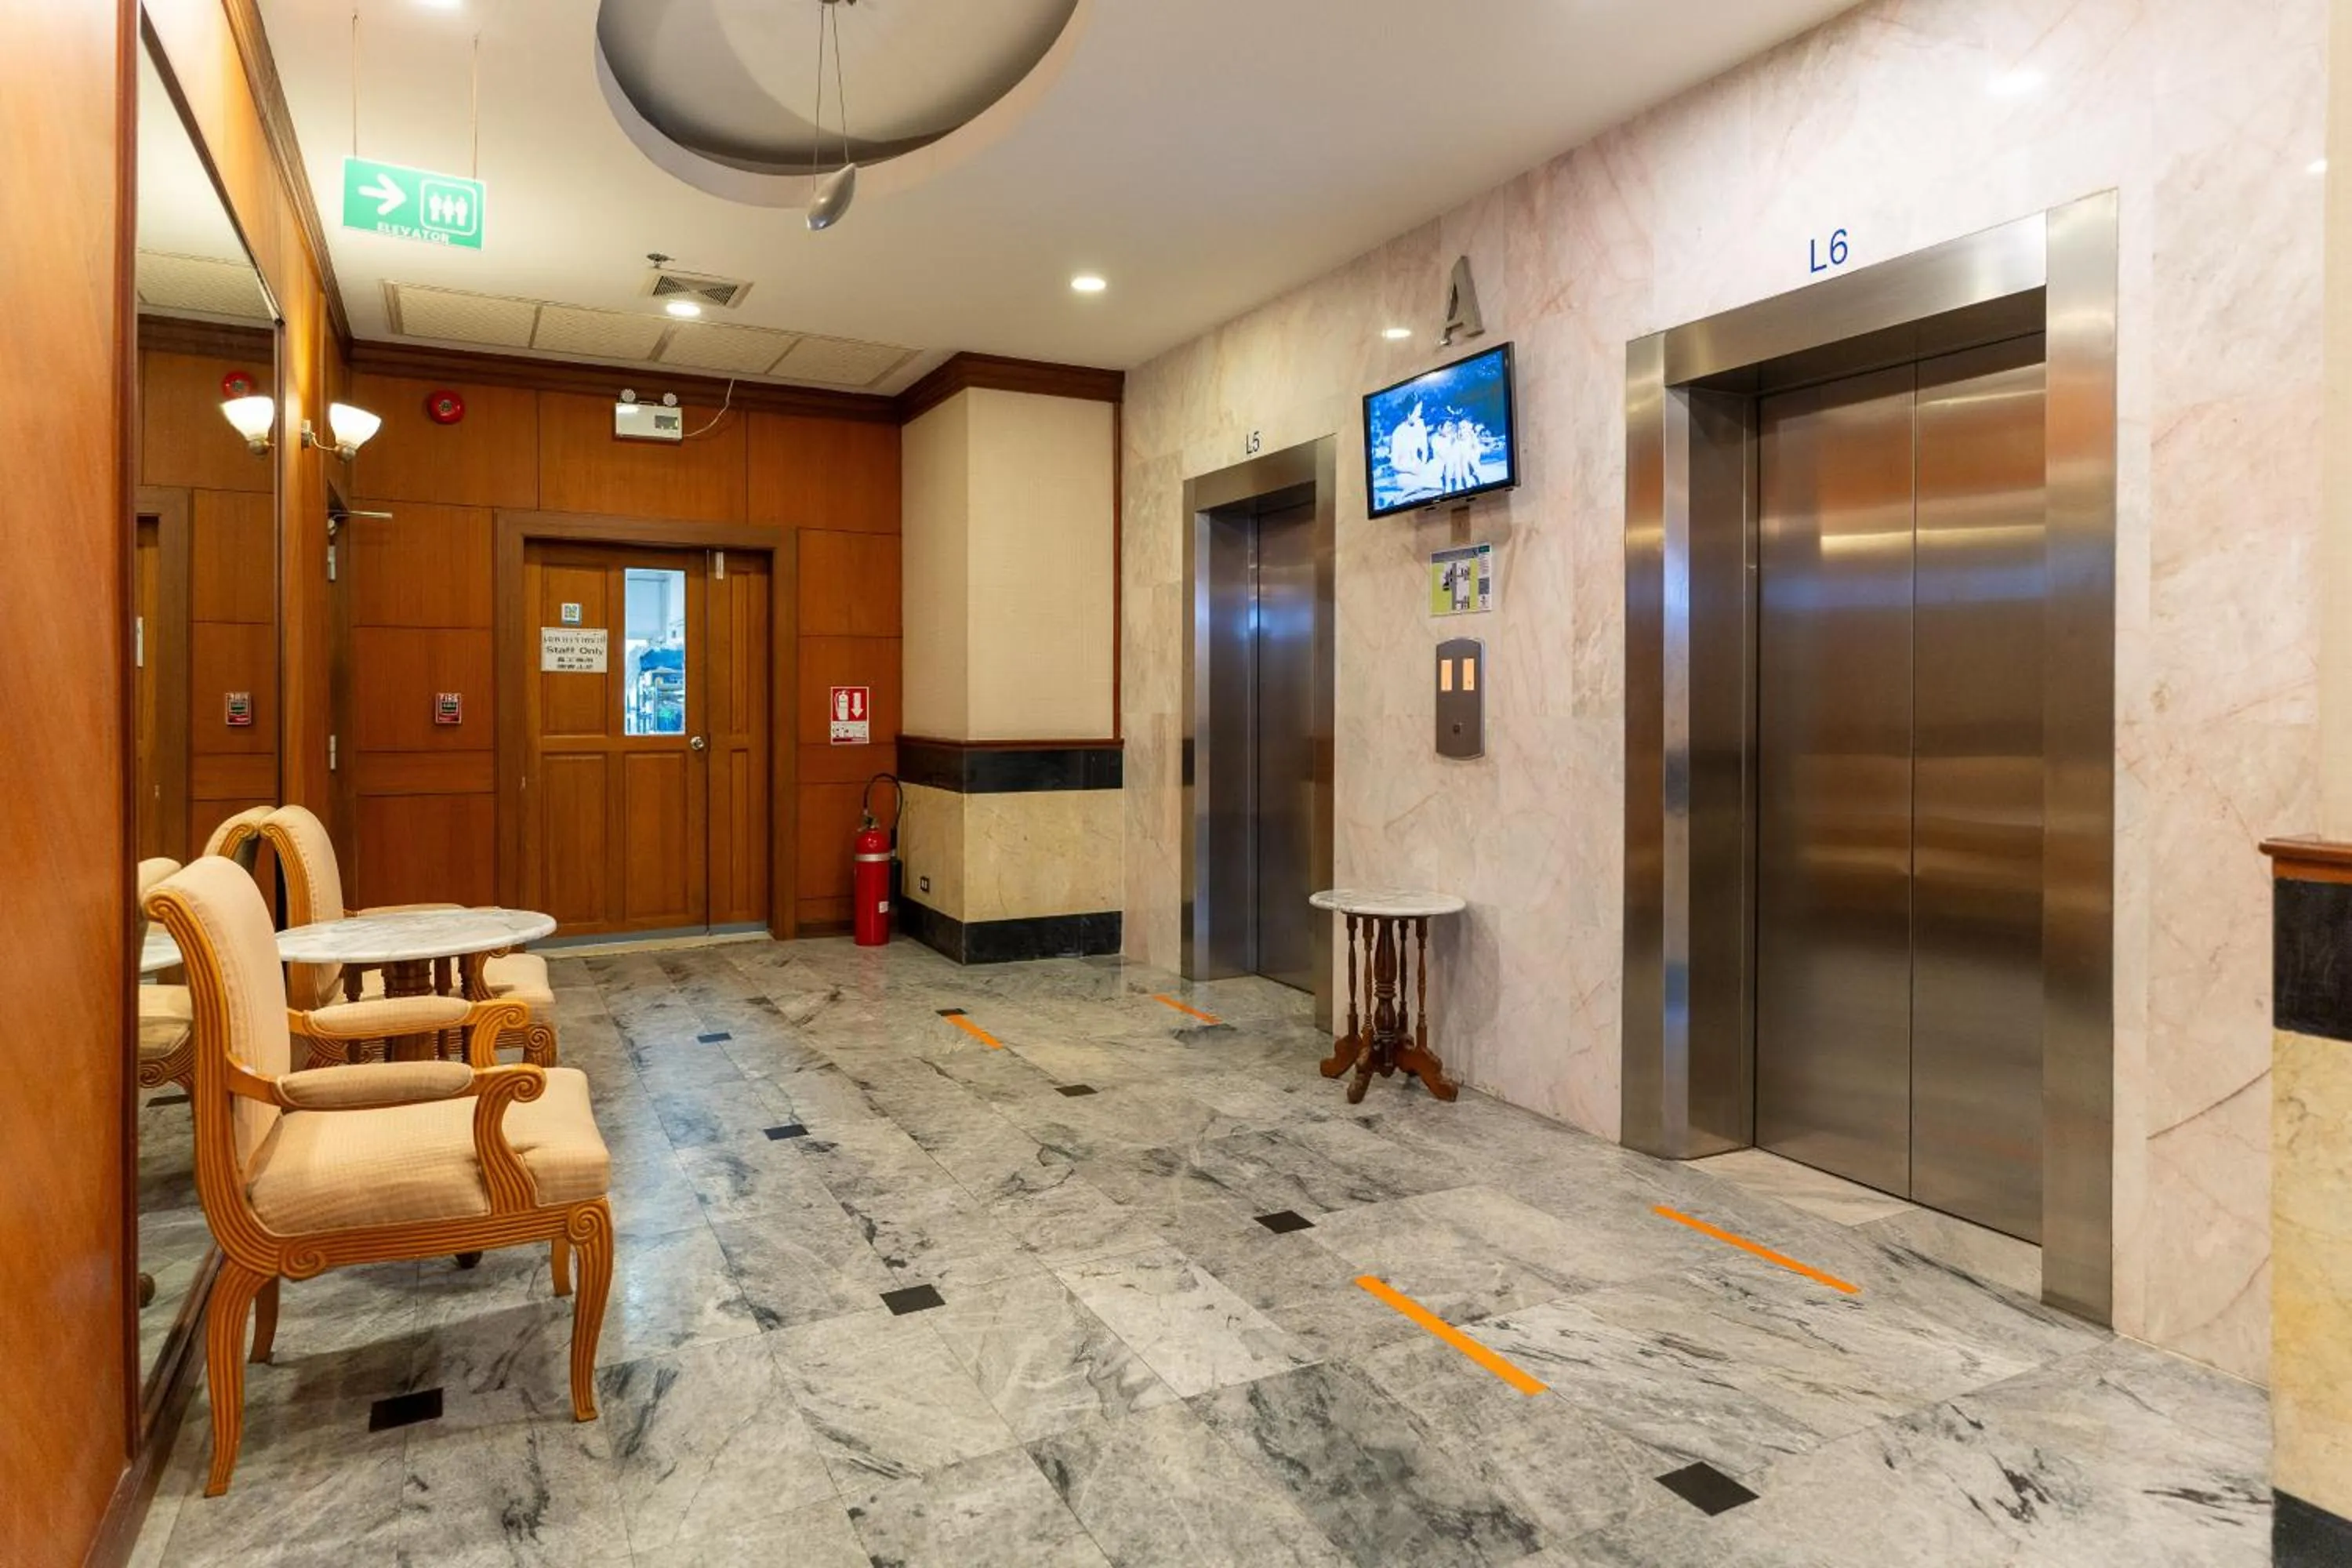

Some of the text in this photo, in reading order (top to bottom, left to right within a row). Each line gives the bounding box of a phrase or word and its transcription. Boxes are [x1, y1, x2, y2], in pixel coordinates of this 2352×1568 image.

[376, 221, 450, 245] ELEVATOR
[1810, 228, 1848, 274] L6
[1246, 430, 1260, 455] L5
[546, 645, 603, 656] Staff Only
